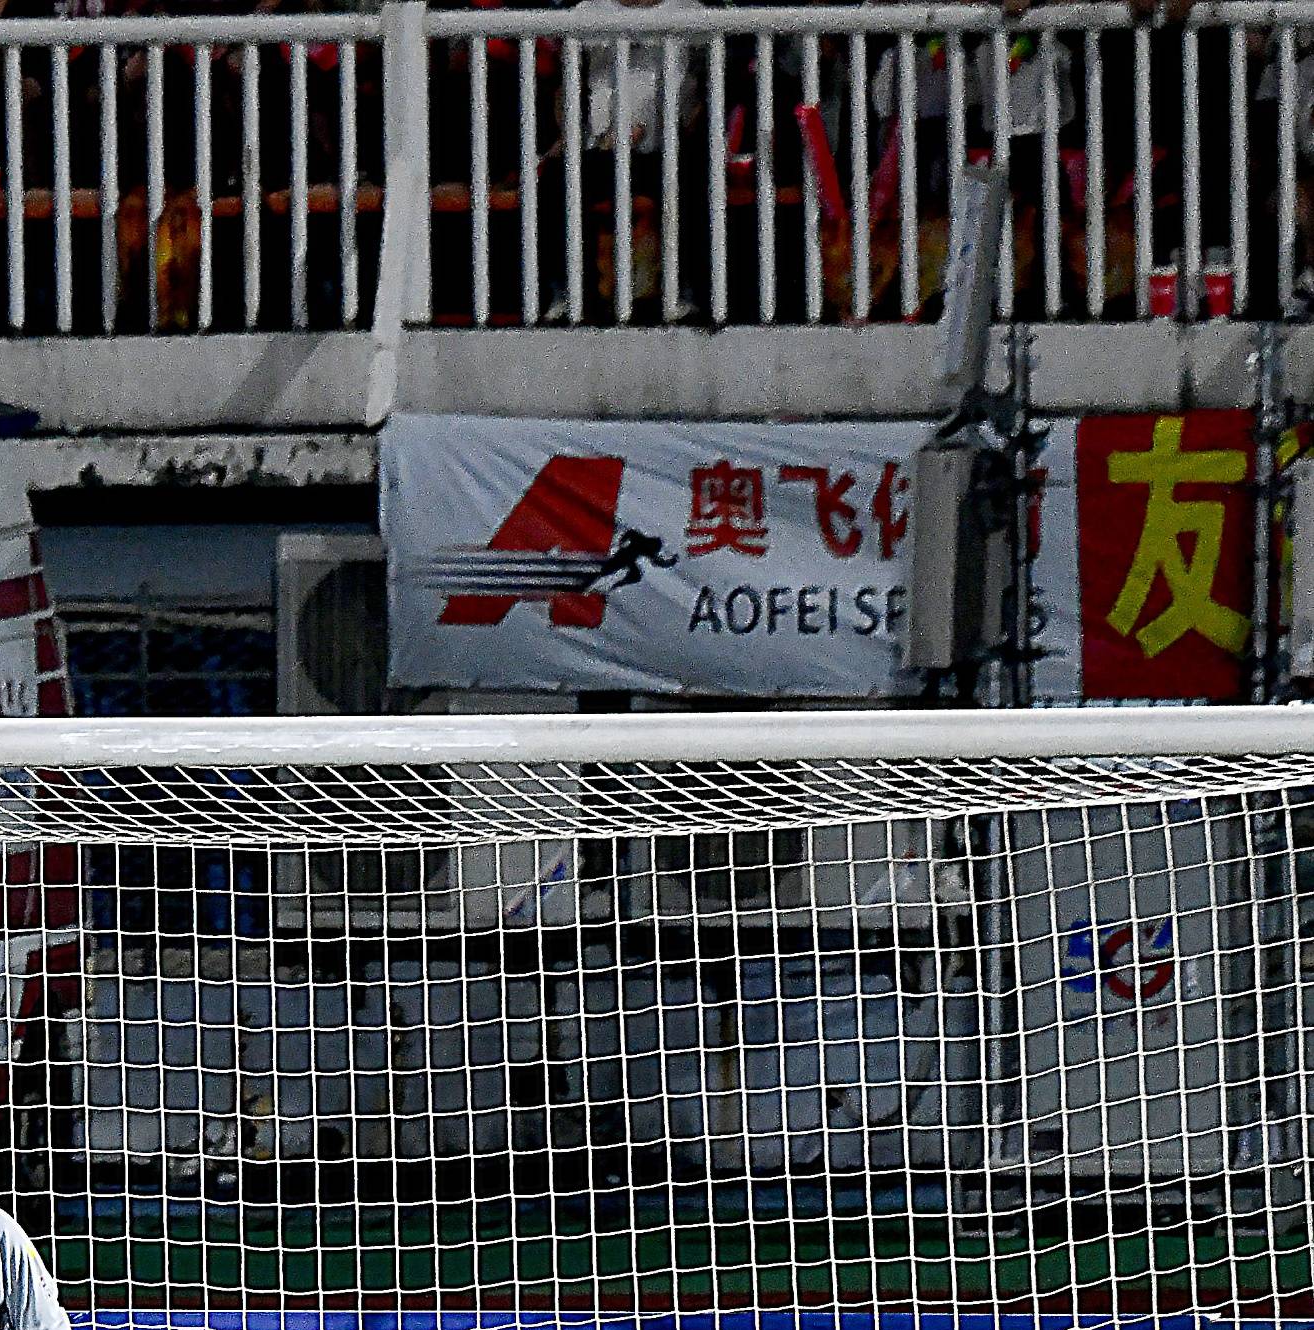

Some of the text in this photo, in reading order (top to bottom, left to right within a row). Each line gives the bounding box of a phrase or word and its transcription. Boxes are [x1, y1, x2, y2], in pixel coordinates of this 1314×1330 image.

[684, 459, 1049, 560] 奥飞
[1106, 415, 1295, 660] 友
[687, 584, 840, 637] AOFEI
